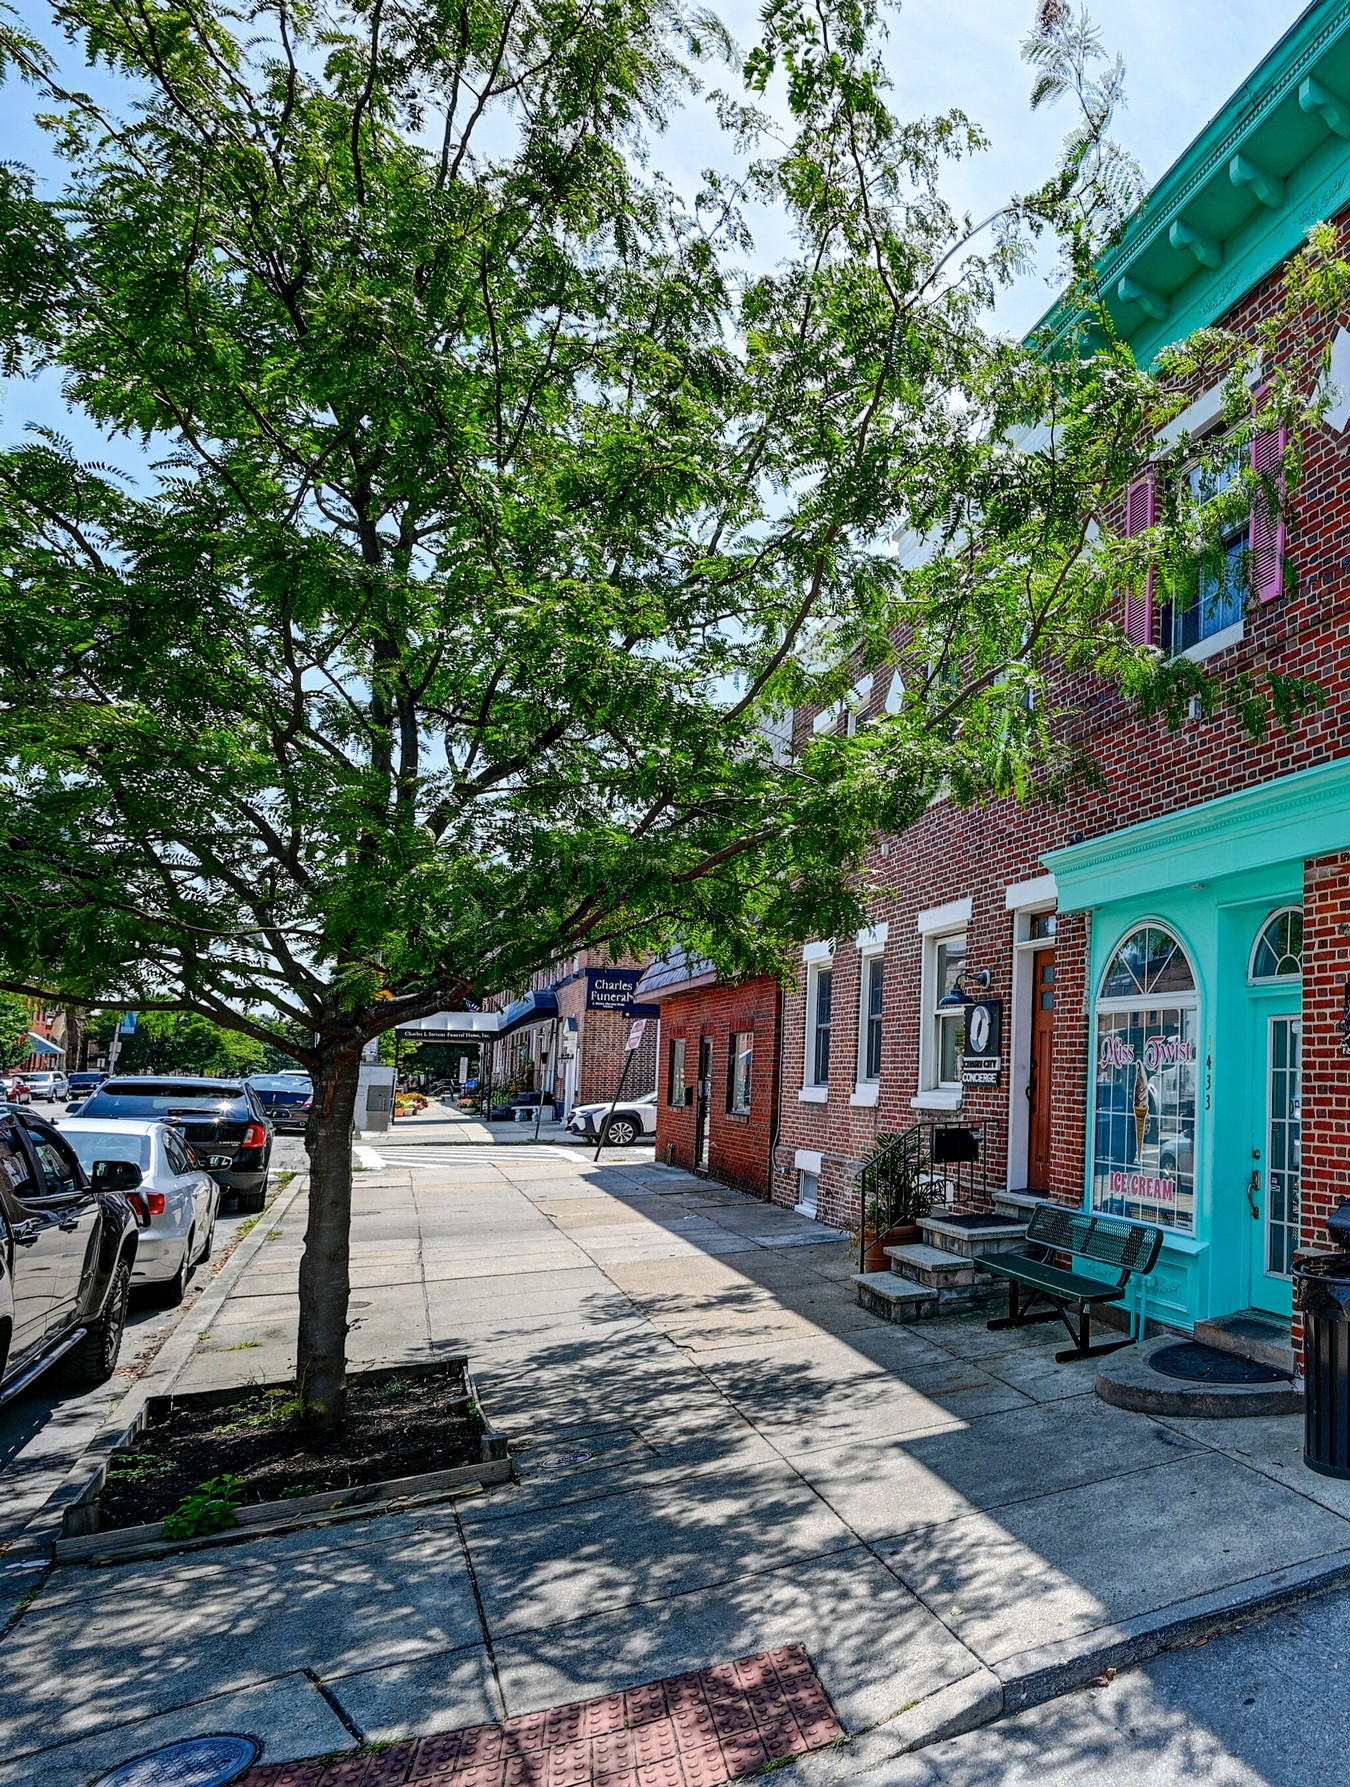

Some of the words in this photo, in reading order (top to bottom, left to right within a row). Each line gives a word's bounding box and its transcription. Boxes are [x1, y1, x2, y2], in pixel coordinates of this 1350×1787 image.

[594, 979, 633, 991] Charles
[591, 991, 629, 1002] Funeral
[1100, 1036, 1135, 1069] Miss
[1144, 1035, 1192, 1072] Twist
[983, 1060, 997, 1068] CITY
[962, 1073, 997, 1083] CONCIERGE
[1108, 1170, 1128, 1194] ICE
[1130, 1174, 1175, 1203] CREAM
